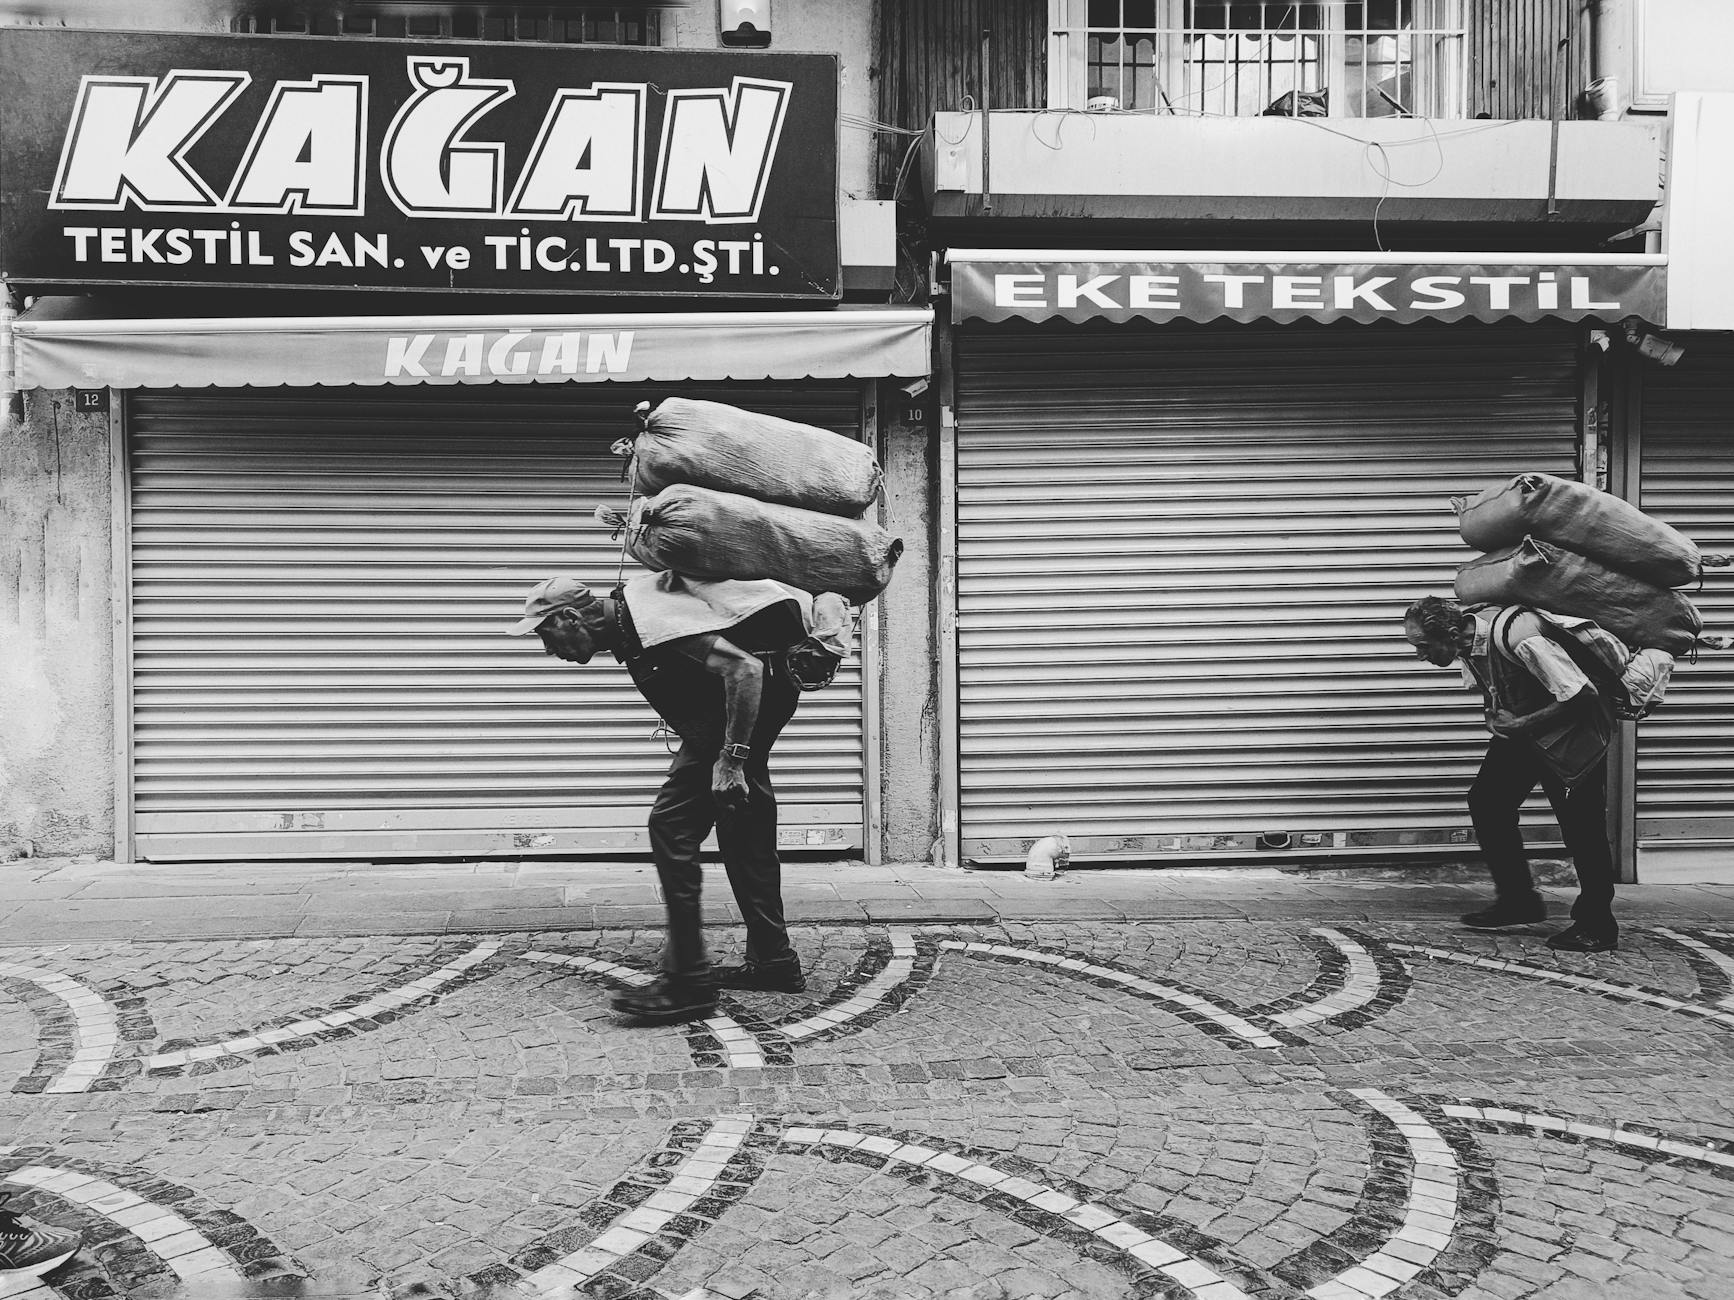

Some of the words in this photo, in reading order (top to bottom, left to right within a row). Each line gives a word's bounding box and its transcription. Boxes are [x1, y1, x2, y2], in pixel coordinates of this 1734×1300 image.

[47, 55, 794, 224] KAĞAN
[63, 221, 274, 265] TEKSTİL
[289, 231, 405, 268] SAN.
[420, 246, 471, 270] ve
[995, 274, 1181, 310] EKE
[84, 393, 99, 406] 12
[908, 408, 922, 421] 10
